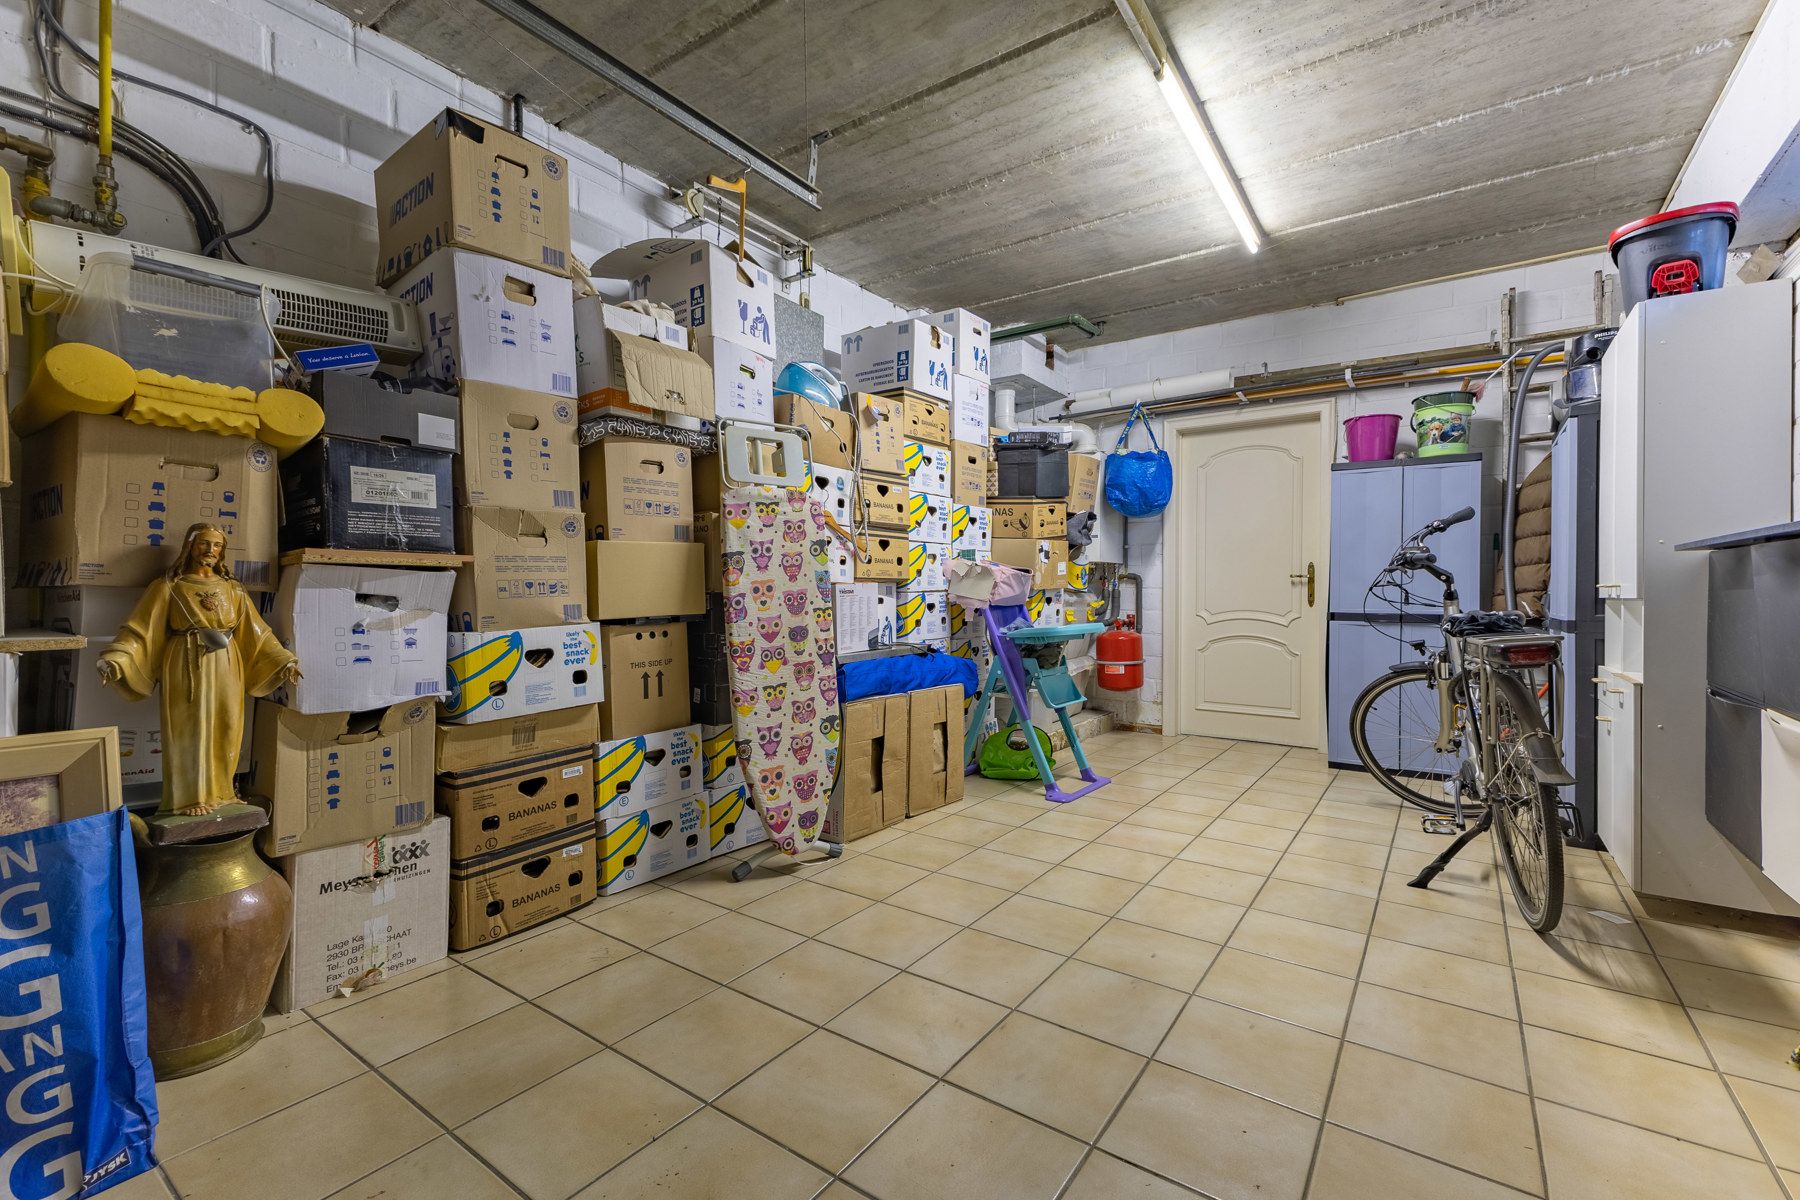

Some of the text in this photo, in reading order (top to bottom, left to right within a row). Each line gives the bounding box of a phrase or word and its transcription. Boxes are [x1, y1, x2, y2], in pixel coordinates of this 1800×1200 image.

[873, 501, 894, 510] BANANAS
[874, 557, 894, 565] BANANAS
[565, 631, 580, 639] likely
[562, 641, 583, 650] best
[565, 648, 590, 658] snack
[563, 657, 586, 666] ever
[630, 658, 673, 669] THIS SIDE UP
[670, 741, 688, 750] best
[672, 747, 694, 757] snack
[671, 756, 691, 766] ever
[508, 800, 558, 822] BANANAS
[679, 809, 695, 819] best
[681, 814, 700, 826] snack
[680, 823, 698, 833] ever
[512, 883, 561, 909] BANANAS
[326, 937, 350, 952] Lage
[326, 948, 349, 962] 2930
[326, 955, 359, 973] Tel.: 03
[326, 971, 346, 983] Fax:
[347, 965, 359, 976] 03
[91, 1151, 128, 1183] JYSK
